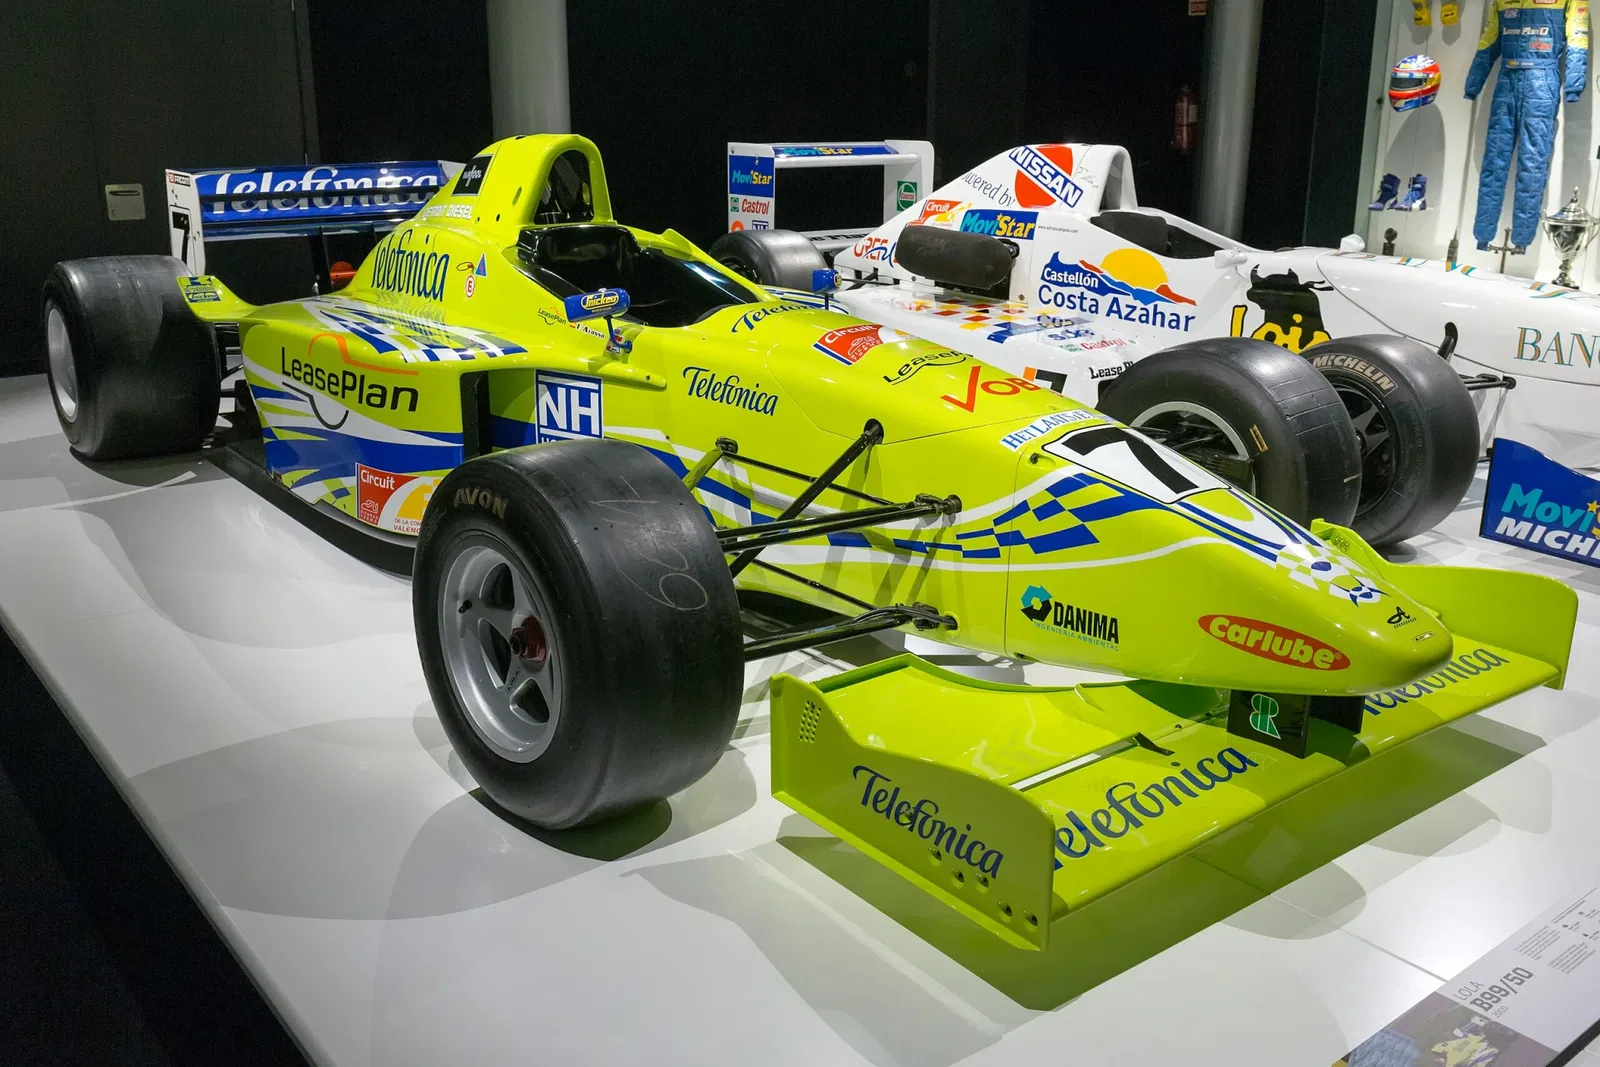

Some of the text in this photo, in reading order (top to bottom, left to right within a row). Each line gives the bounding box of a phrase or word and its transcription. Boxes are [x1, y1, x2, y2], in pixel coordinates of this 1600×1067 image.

[732, 171, 772, 185] MoviStar
[962, 171, 1016, 207] owered by
[1012, 147, 1081, 206] NISSAN
[447, 204, 472, 220] DIESEL
[741, 198, 770, 215] Castrol
[926, 202, 950, 212] Circuit
[961, 211, 1036, 238] MoviStar
[1043, 267, 1099, 288] Castellón
[537, 307, 567, 325] LeasePlan
[1038, 284, 1100, 315] Costa
[1105, 297, 1197, 333] Azahar
[824, 325, 877, 344] Circuit
[1513, 326, 1600, 369] BAN
[282, 346, 419, 412] LeasePlan
[1089, 365, 1123, 380] Lease
[1312, 354, 1395, 391] MICHELIN
[538, 383, 600, 435] NH
[1002, 423, 1035, 449] HET
[1061, 427, 1200, 495] 7
[360, 469, 395, 490] Circuit
[453, 486, 507, 519] AVON
[1501, 482, 1600, 541] Movi
[1033, 620, 1120, 652] INGENIERIA AMBIENTAL
[1053, 601, 1119, 645] DANIMA
[1453, 981, 1485, 1001] LOLA
[1469, 967, 1534, 1013] B99/50
